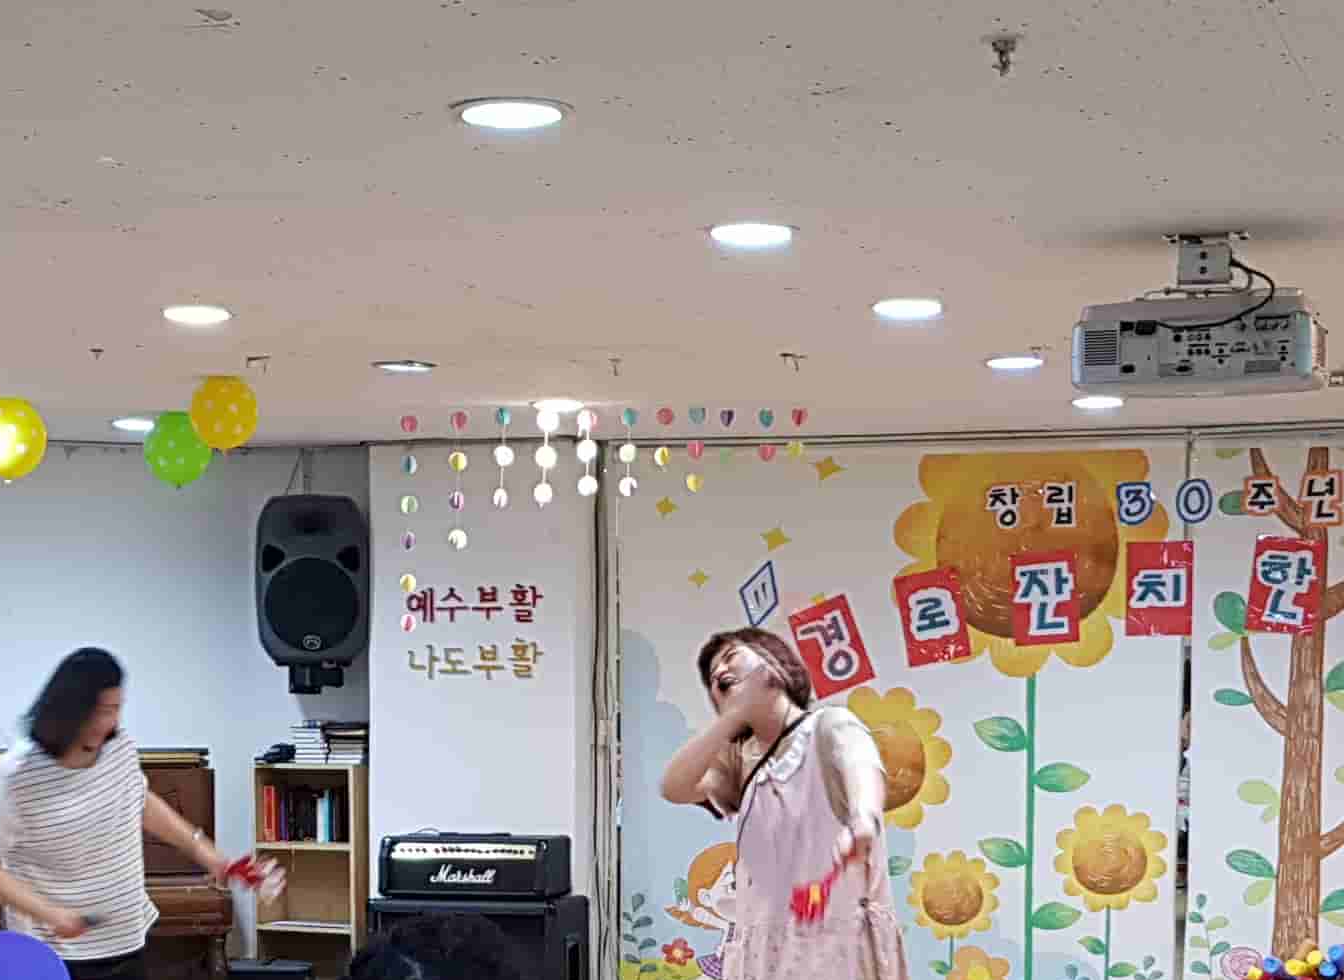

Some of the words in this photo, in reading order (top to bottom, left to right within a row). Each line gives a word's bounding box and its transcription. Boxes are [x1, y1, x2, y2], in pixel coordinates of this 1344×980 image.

[988, 483, 1075, 527] 창립
[406, 583, 544, 623] 예수부활
[407, 637, 544, 681] 나도부활
[429, 863, 497, 884] Marshall
